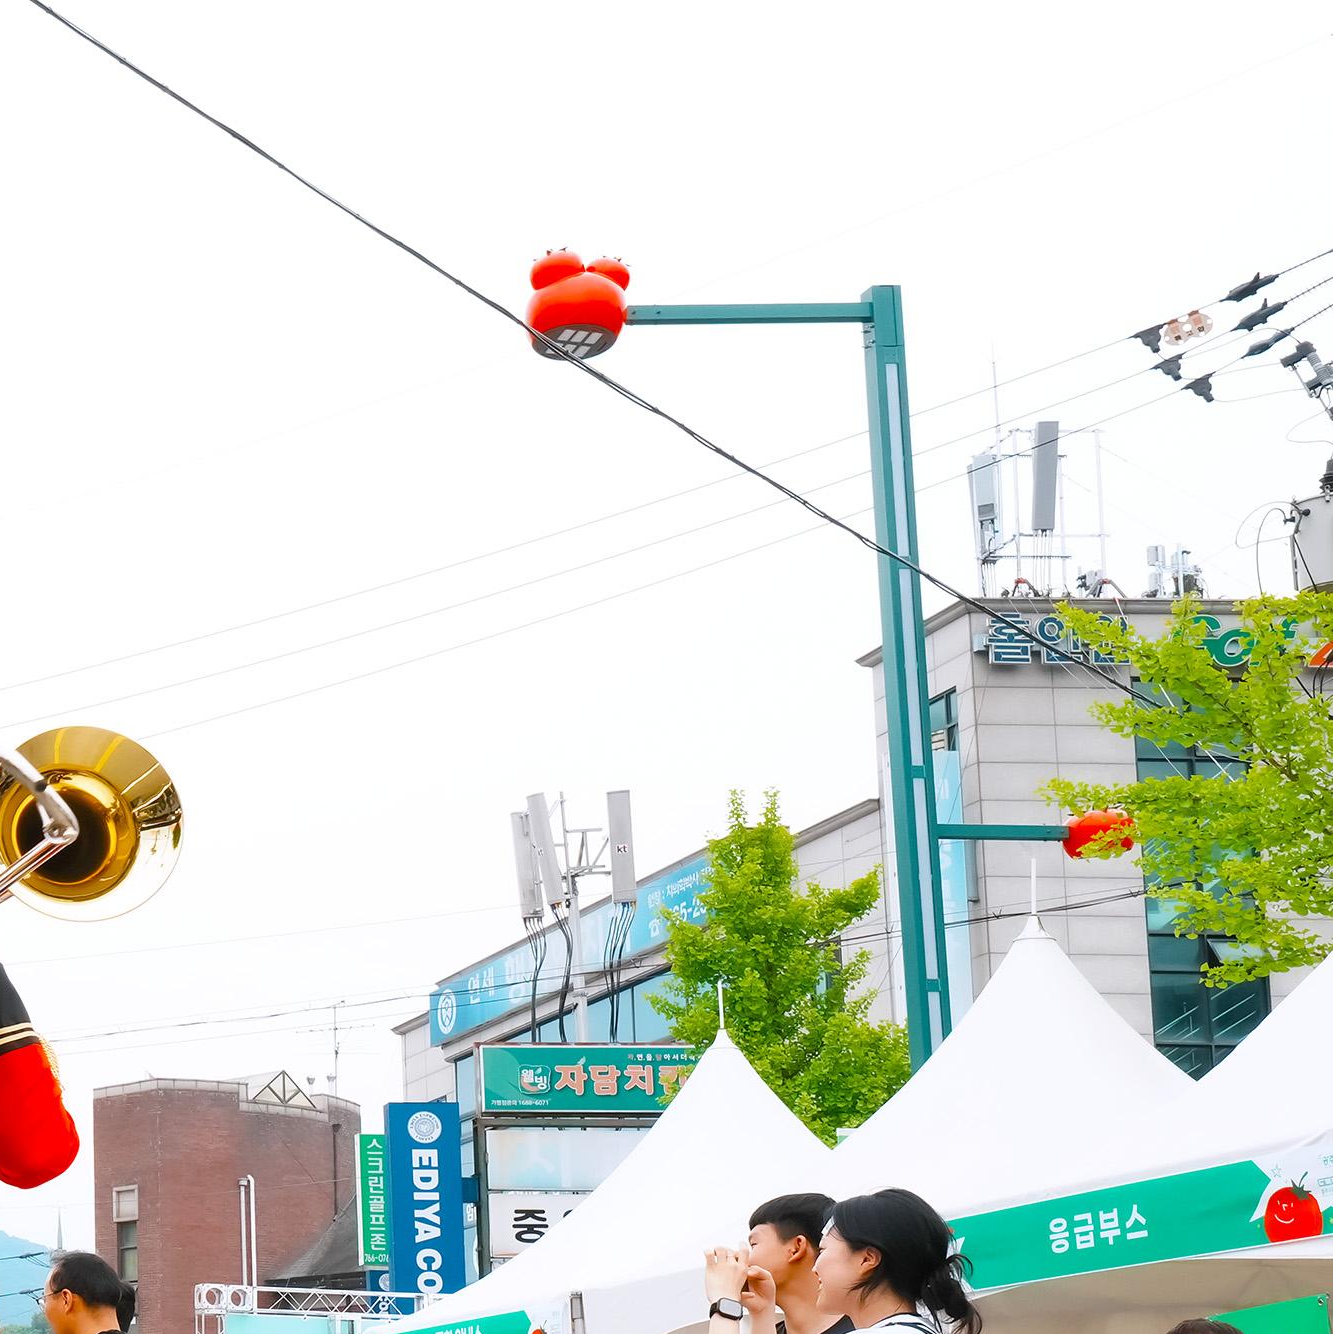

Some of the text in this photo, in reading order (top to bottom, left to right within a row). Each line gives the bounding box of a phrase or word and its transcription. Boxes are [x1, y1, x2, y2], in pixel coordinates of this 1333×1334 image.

[616, 845, 628, 853] kt
[521, 1067, 548, 1090] 웰빙
[367, 1138, 386, 1251] 스크린골프존
[412, 1149, 442, 1243] EDIYA
[1049, 1204, 1148, 1253] 응급부스
